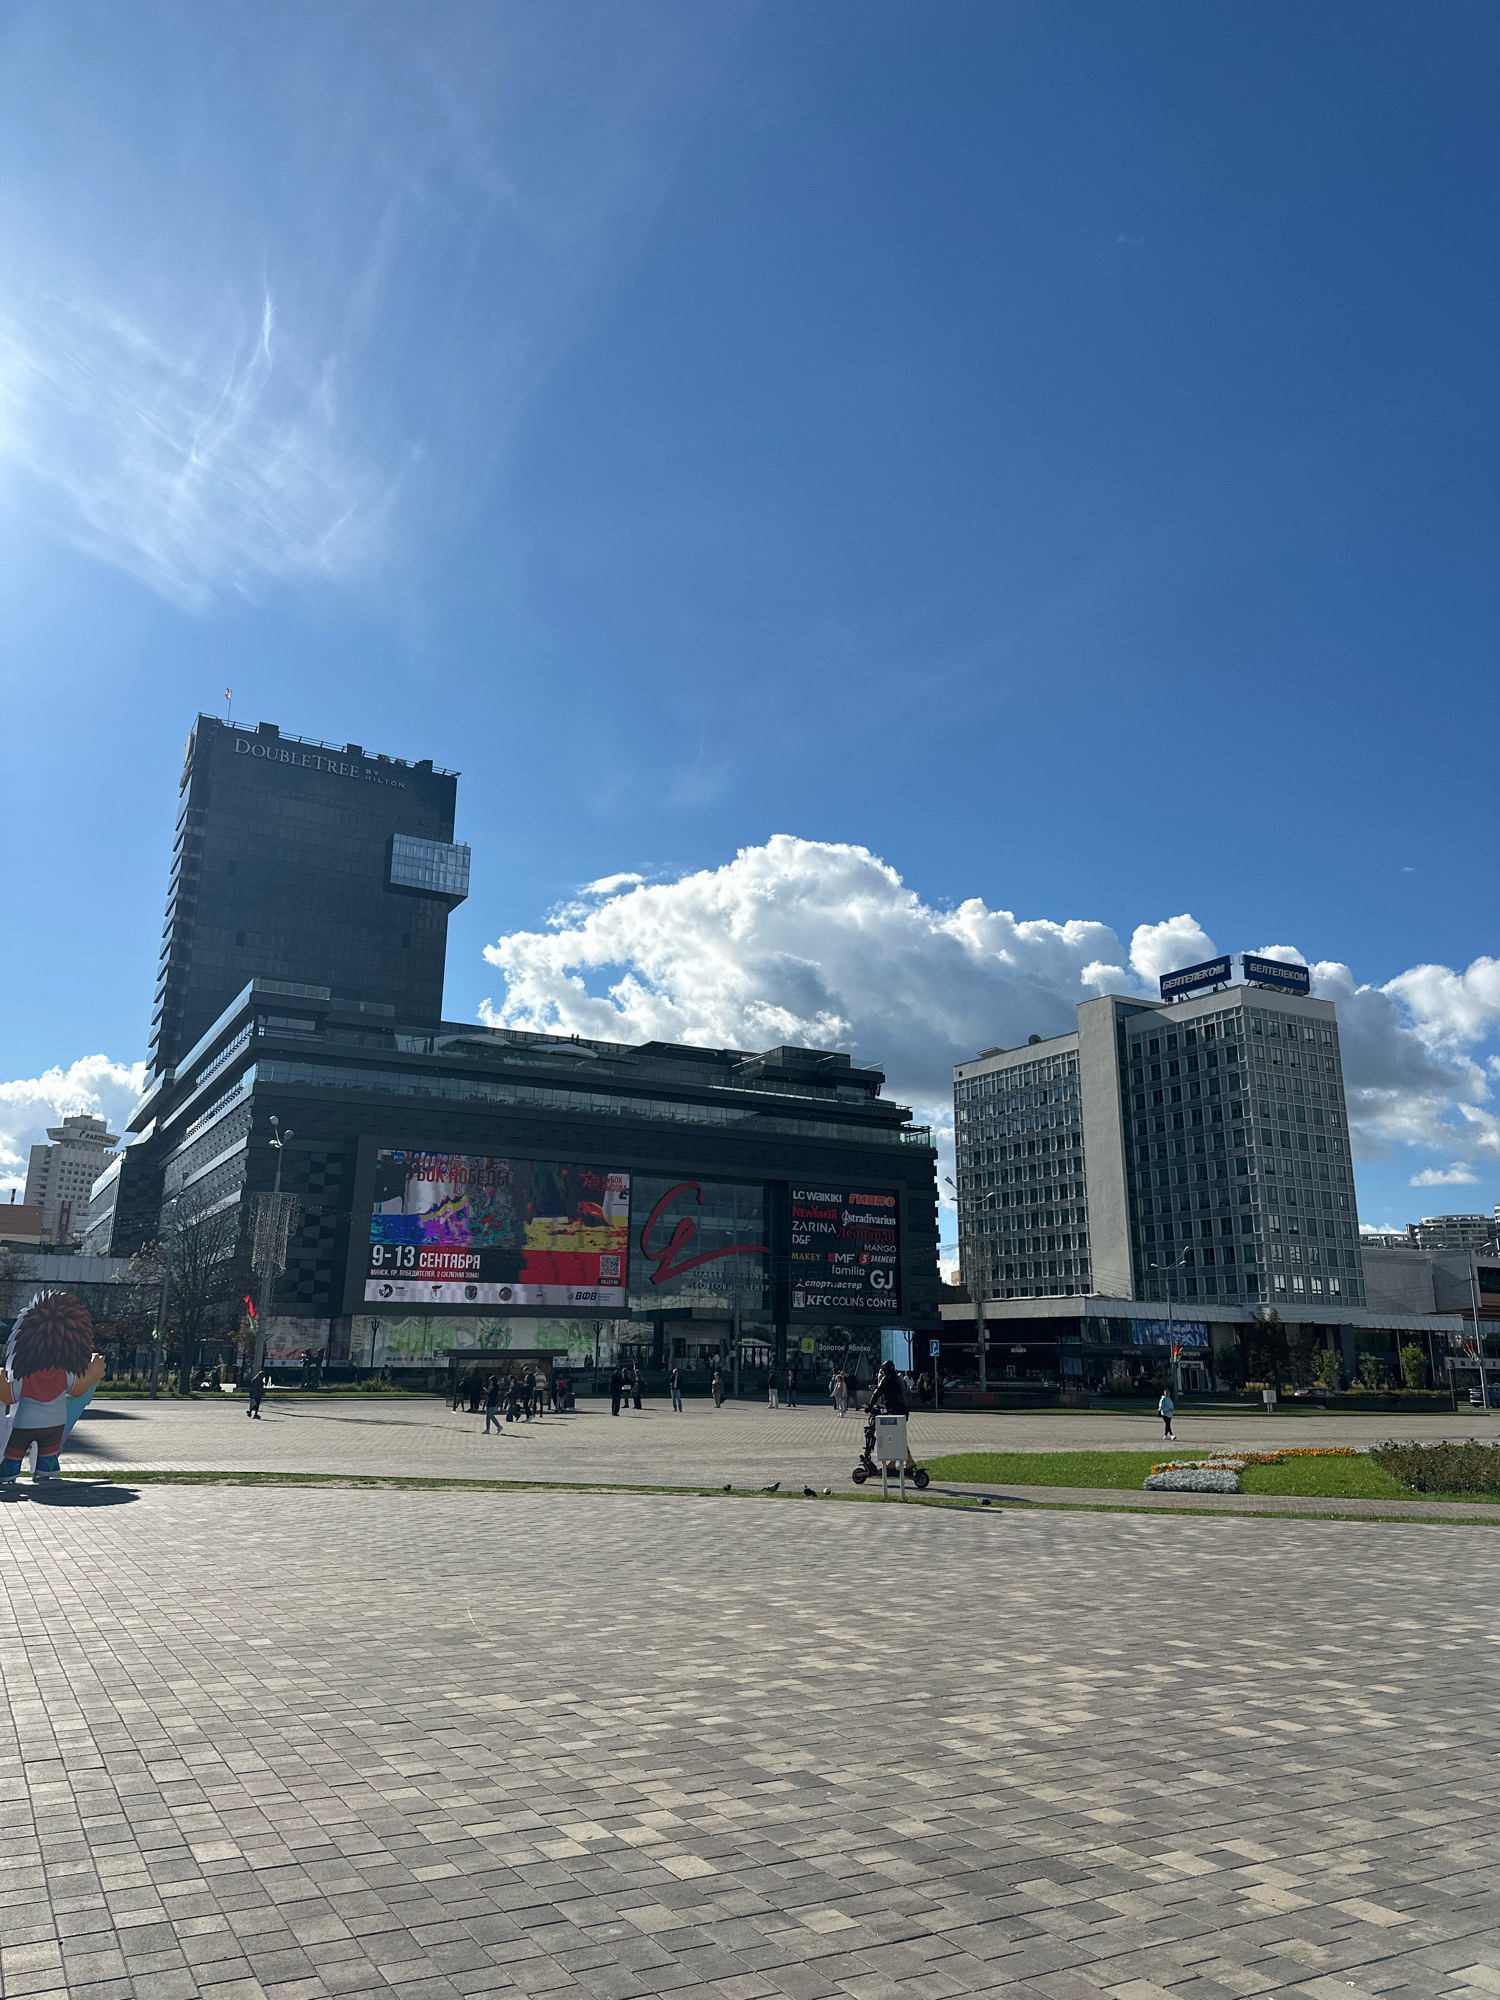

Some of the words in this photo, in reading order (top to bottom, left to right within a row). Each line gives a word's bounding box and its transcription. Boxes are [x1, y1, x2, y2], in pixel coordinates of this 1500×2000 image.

[365, 768, 380, 777] BY
[364, 775, 406, 789] HILTON
[1162, 964, 1225, 991] БЕЛТЕЛЕКОМ
[1249, 962, 1307, 983] БЕЛТЕЛЕКОМ
[602, 1176, 623, 1185] КУБОК
[793, 1190, 806, 1200] LC
[849, 1193, 896, 1208] ГИППО
[792, 1221, 837, 1233] ZARINA
[836, 1226, 896, 1243] Леонардо
[864, 1243, 897, 1253] MANGO
[419, 1252, 481, 1269] СЕНТЯБРЯ
[835, 1253, 855, 1264] MF
[861, 1254, 868, 1264] 5
[870, 1256, 897, 1264] ЭЛЕМЕНТ
[743, 1272, 770, 1280] MINSK
[832, 1265, 866, 1276] familia
[869, 1269, 894, 1290] GJ
[574, 1291, 597, 1301] ВФВ
[806, 1295, 832, 1306] KFC
[832, 1295, 864, 1307] COLIN'S
[866, 1298, 898, 1308] CONTE
[818, 1343, 845, 1351] Золотое
[848, 1344, 872, 1352] Яблоко
